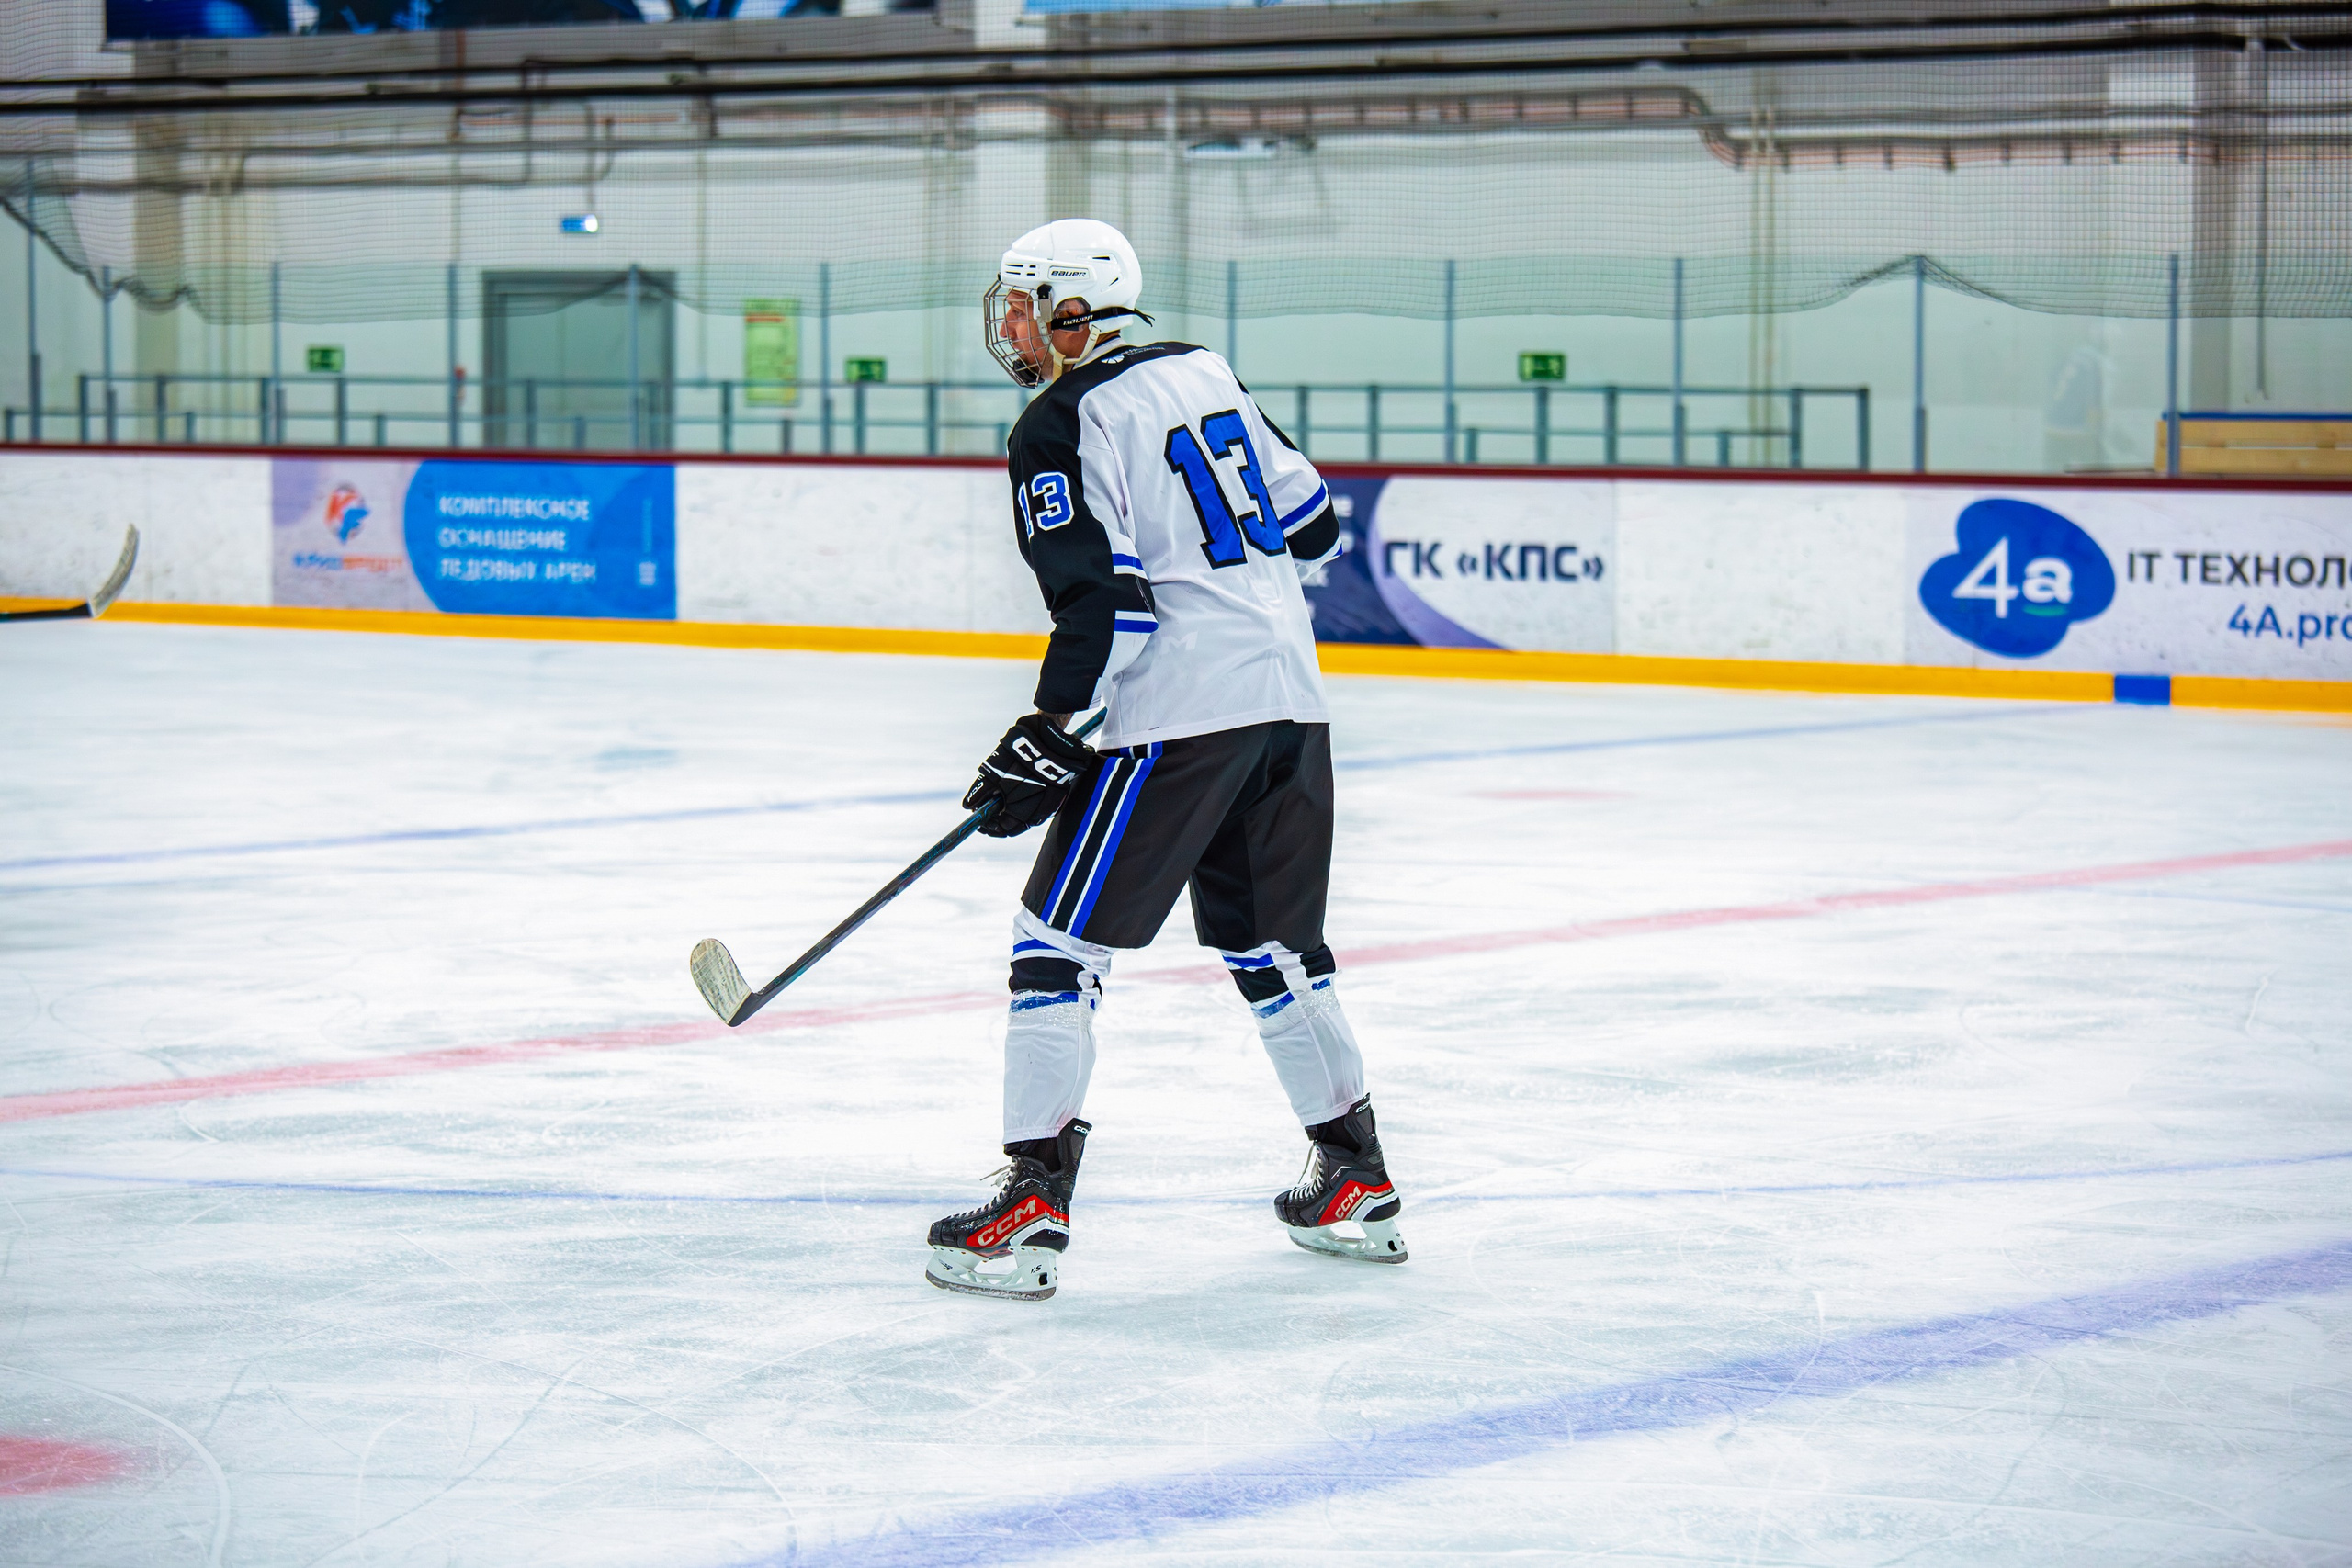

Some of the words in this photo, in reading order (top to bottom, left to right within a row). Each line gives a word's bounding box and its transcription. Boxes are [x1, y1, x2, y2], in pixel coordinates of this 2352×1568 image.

[439, 495, 590, 521] КОМПЛЕКСНОЕ
[1164, 408, 1286, 570] 13
[1383, 541, 1442, 578] ГК
[1457, 543, 1604, 582] «КПС»
[2128, 551, 2161, 582] IT
[2175, 552, 2352, 589] ТЕХНОЛ
[1335, 1186, 1361, 1219] CCM
[978, 1200, 1036, 1247] CCM
